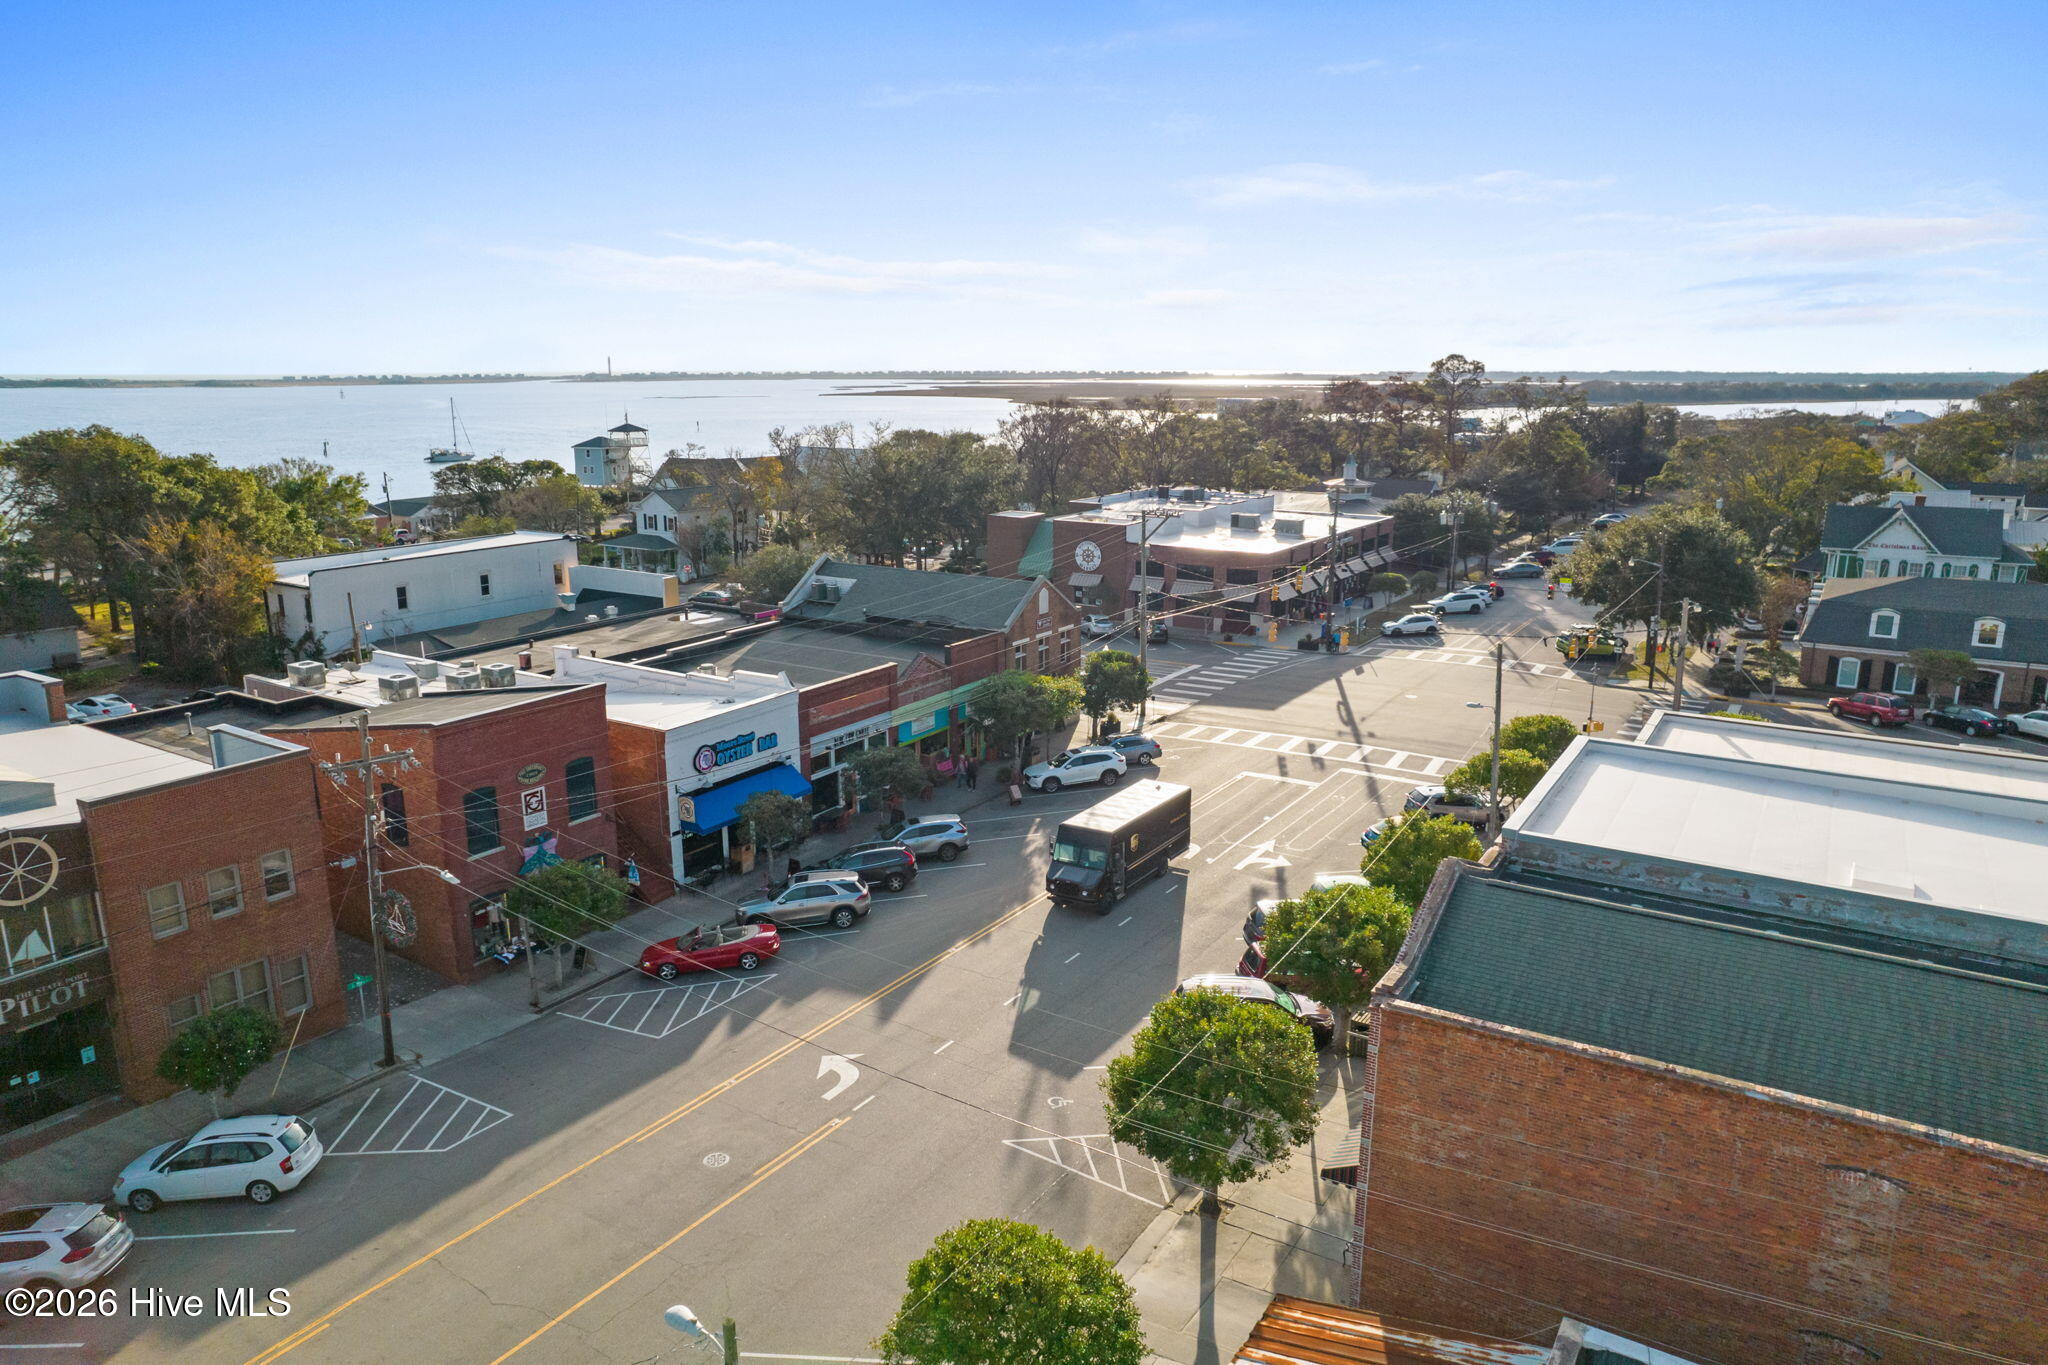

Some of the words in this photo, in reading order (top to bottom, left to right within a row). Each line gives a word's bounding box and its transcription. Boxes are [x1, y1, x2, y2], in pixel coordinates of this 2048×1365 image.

[717, 742, 753, 767] OYSTER
[758, 733, 778, 752] BAR
[0, 977, 91, 1025] PILOT
[16, 990, 34, 1001] THE
[64, 972, 89, 983] PORT
